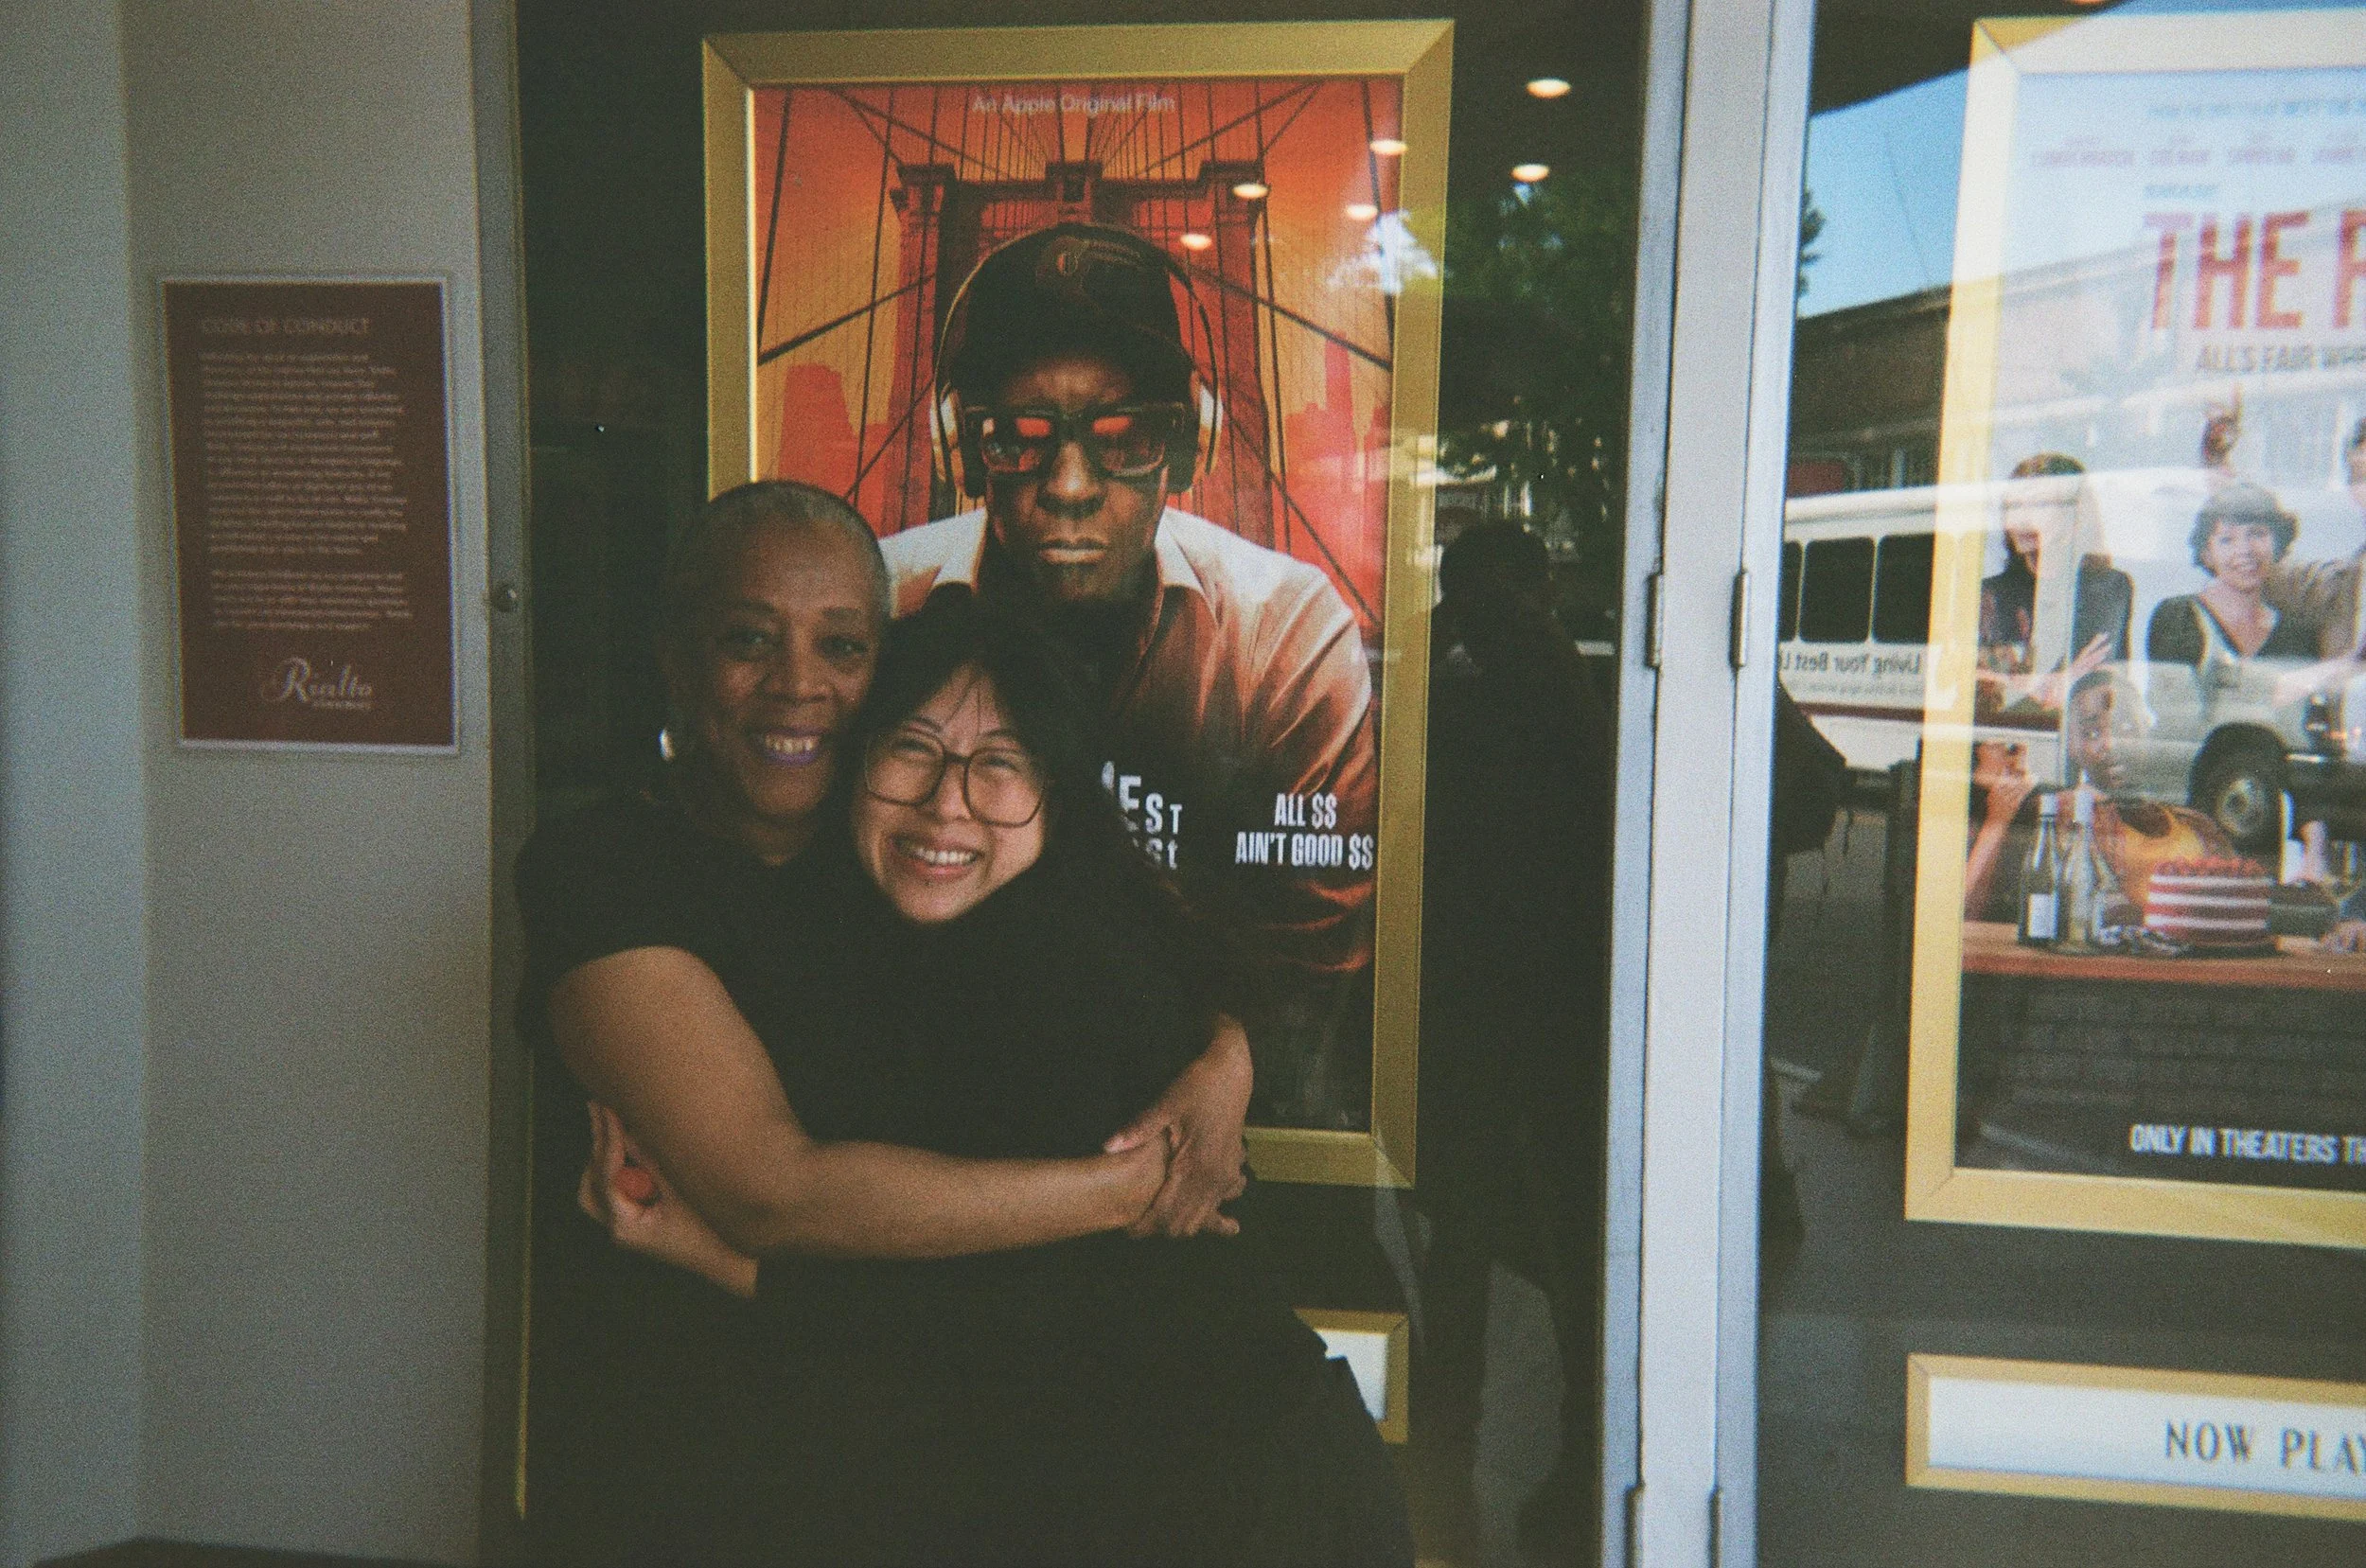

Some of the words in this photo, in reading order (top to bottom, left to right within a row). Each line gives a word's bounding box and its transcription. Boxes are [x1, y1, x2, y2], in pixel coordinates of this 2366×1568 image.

[973, 95, 997, 113] An
[1002, 95, 1056, 115] Apple
[1061, 93, 1133, 118] Original
[1136, 92, 1174, 113] Film
[2143, 210, 2309, 329] THE
[259, 657, 374, 703] Rialto
[1274, 793, 1306, 826] ALL
[1235, 832, 1286, 865] AIN'T
[1291, 833, 1343, 868] GOOD
[2128, 1123, 2186, 1154] ONLY
[2188, 1126, 2216, 1157] IN
[2218, 1127, 2339, 1165] THEATERS
[2164, 1418, 2255, 1462] NOW
